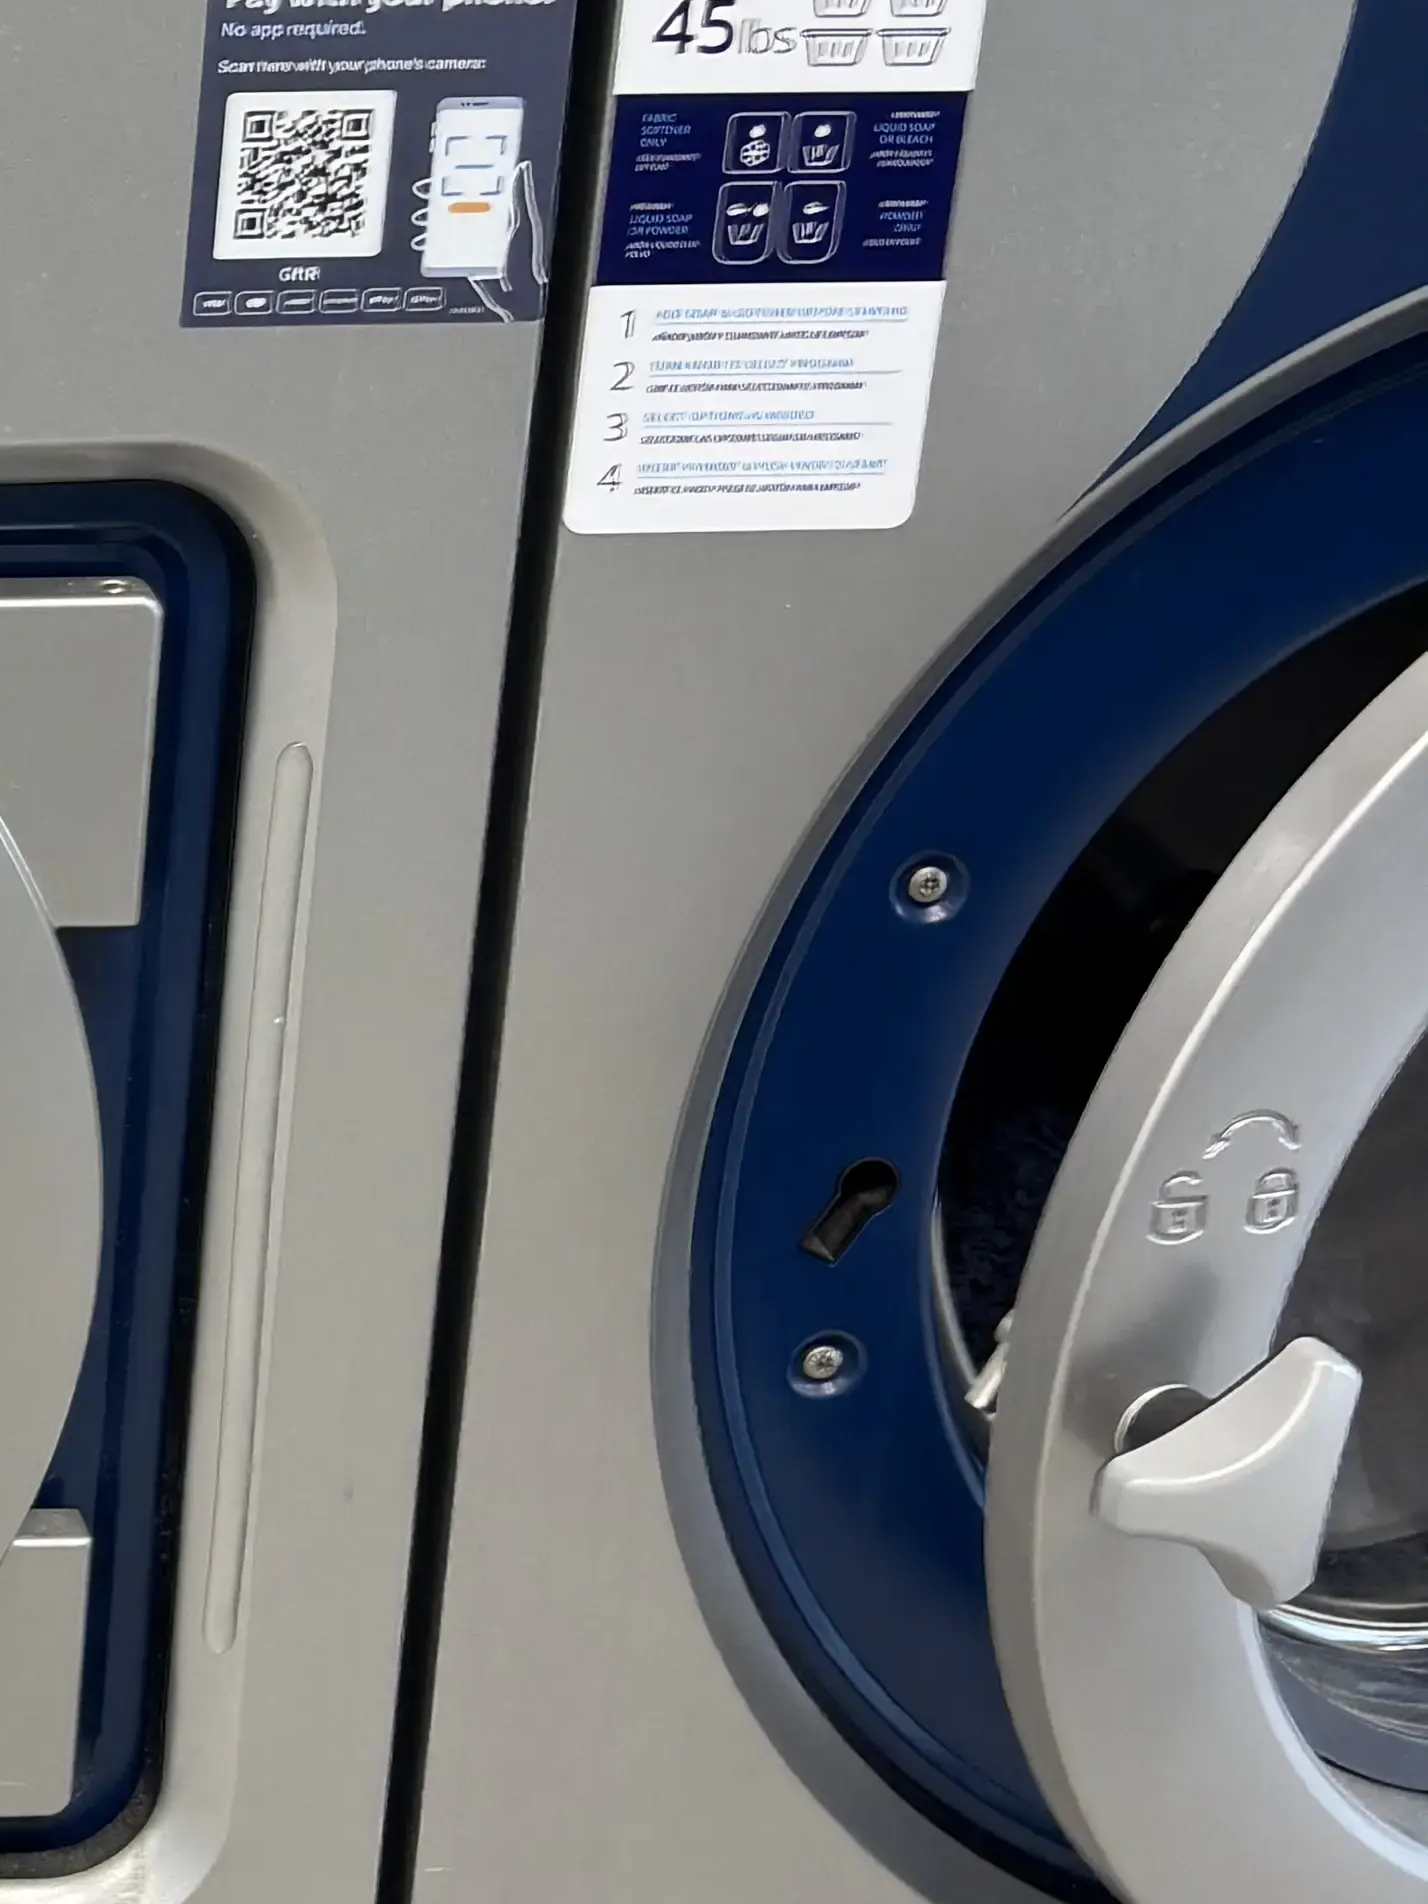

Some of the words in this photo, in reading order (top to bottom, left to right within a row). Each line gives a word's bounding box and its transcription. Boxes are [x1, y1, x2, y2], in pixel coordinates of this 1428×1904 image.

[221, 22, 247, 37] No
[251, 23, 284, 40] app
[286, 19, 367, 40] required.
[217, 59, 254, 74] Scan
[294, 58, 326, 72] with
[328, 59, 365, 75] your
[364, 57, 424, 74] phone's
[620, 309, 637, 339] 1
[609, 361, 635, 391] 2
[603, 412, 629, 442] 3
[596, 462, 622, 492] 4
